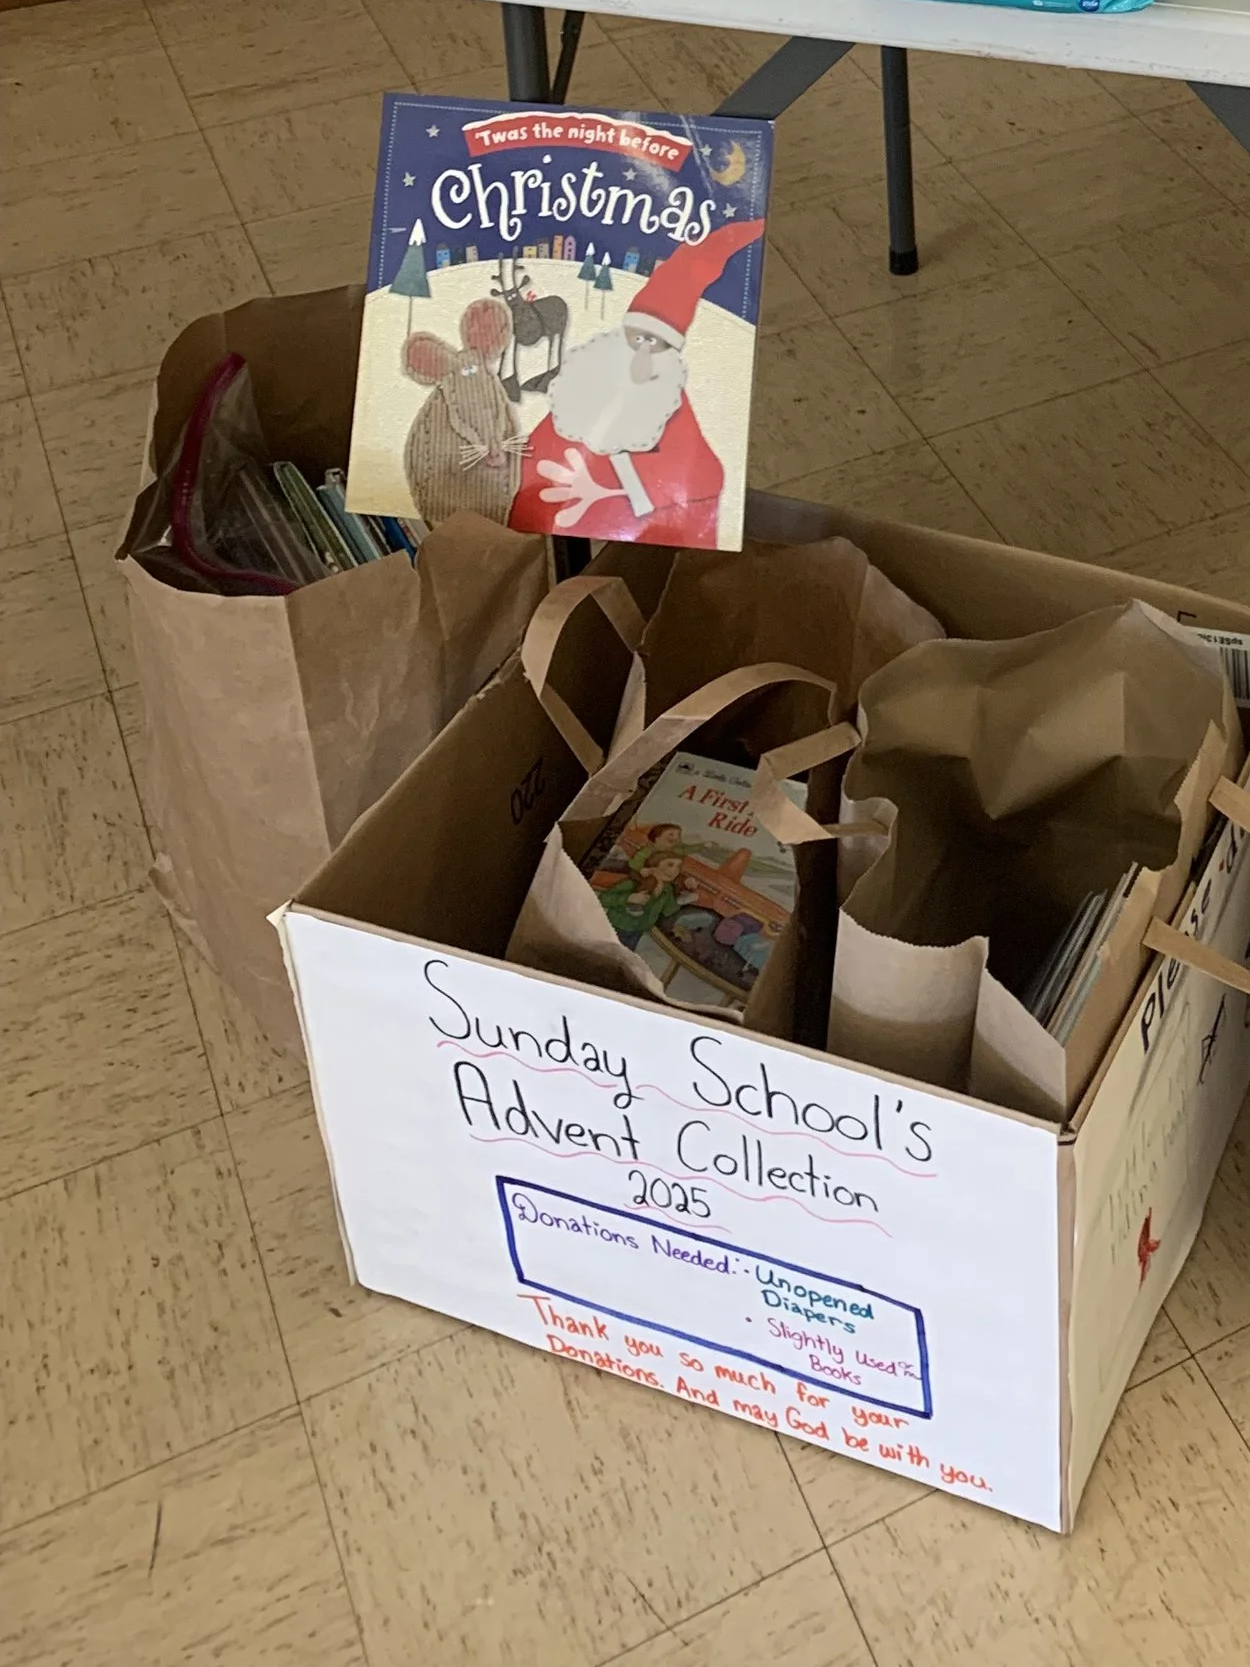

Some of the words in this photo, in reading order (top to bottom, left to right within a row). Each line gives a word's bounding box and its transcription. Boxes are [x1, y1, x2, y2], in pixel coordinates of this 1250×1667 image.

[475, 124, 528, 147] 'Twas
[533, 122, 563, 140] the
[568, 124, 616, 145] night
[620, 130, 680, 162] before
[431, 154, 717, 247] Christmas
[677, 784, 698, 801] A
[699, 788, 751, 814] First
[707, 811, 759, 838] Ride
[424, 960, 645, 1110] Sunday
[690, 1035, 935, 1164] School's
[453, 1060, 641, 1162] Advent
[678, 1120, 879, 1212] Collection
[512, 1193, 640, 1251] Donations
[628, 1170, 713, 1220] 2025
[755, 1264, 875, 1321] Unopened
[761, 1289, 857, 1336] Diapers
[517, 1294, 609, 1342] Thank
[624, 1333, 665, 1359] you
[680, 1351, 706, 1373] so
[714, 1358, 778, 1396] much
[796, 1382, 831, 1410] for
[851, 1403, 911, 1430] your
[767, 1316, 846, 1364] Slightly
[855, 1349, 897, 1378] Used
[809, 1353, 863, 1387] Books
[546, 1334, 665, 1391] Donations.
[676, 1375, 721, 1408] And
[732, 1397, 779, 1428] may
[785, 1407, 831, 1443] God
[842, 1426, 871, 1453] be
[878, 1443, 931, 1471] with
[940, 1462, 995, 1493] you.
